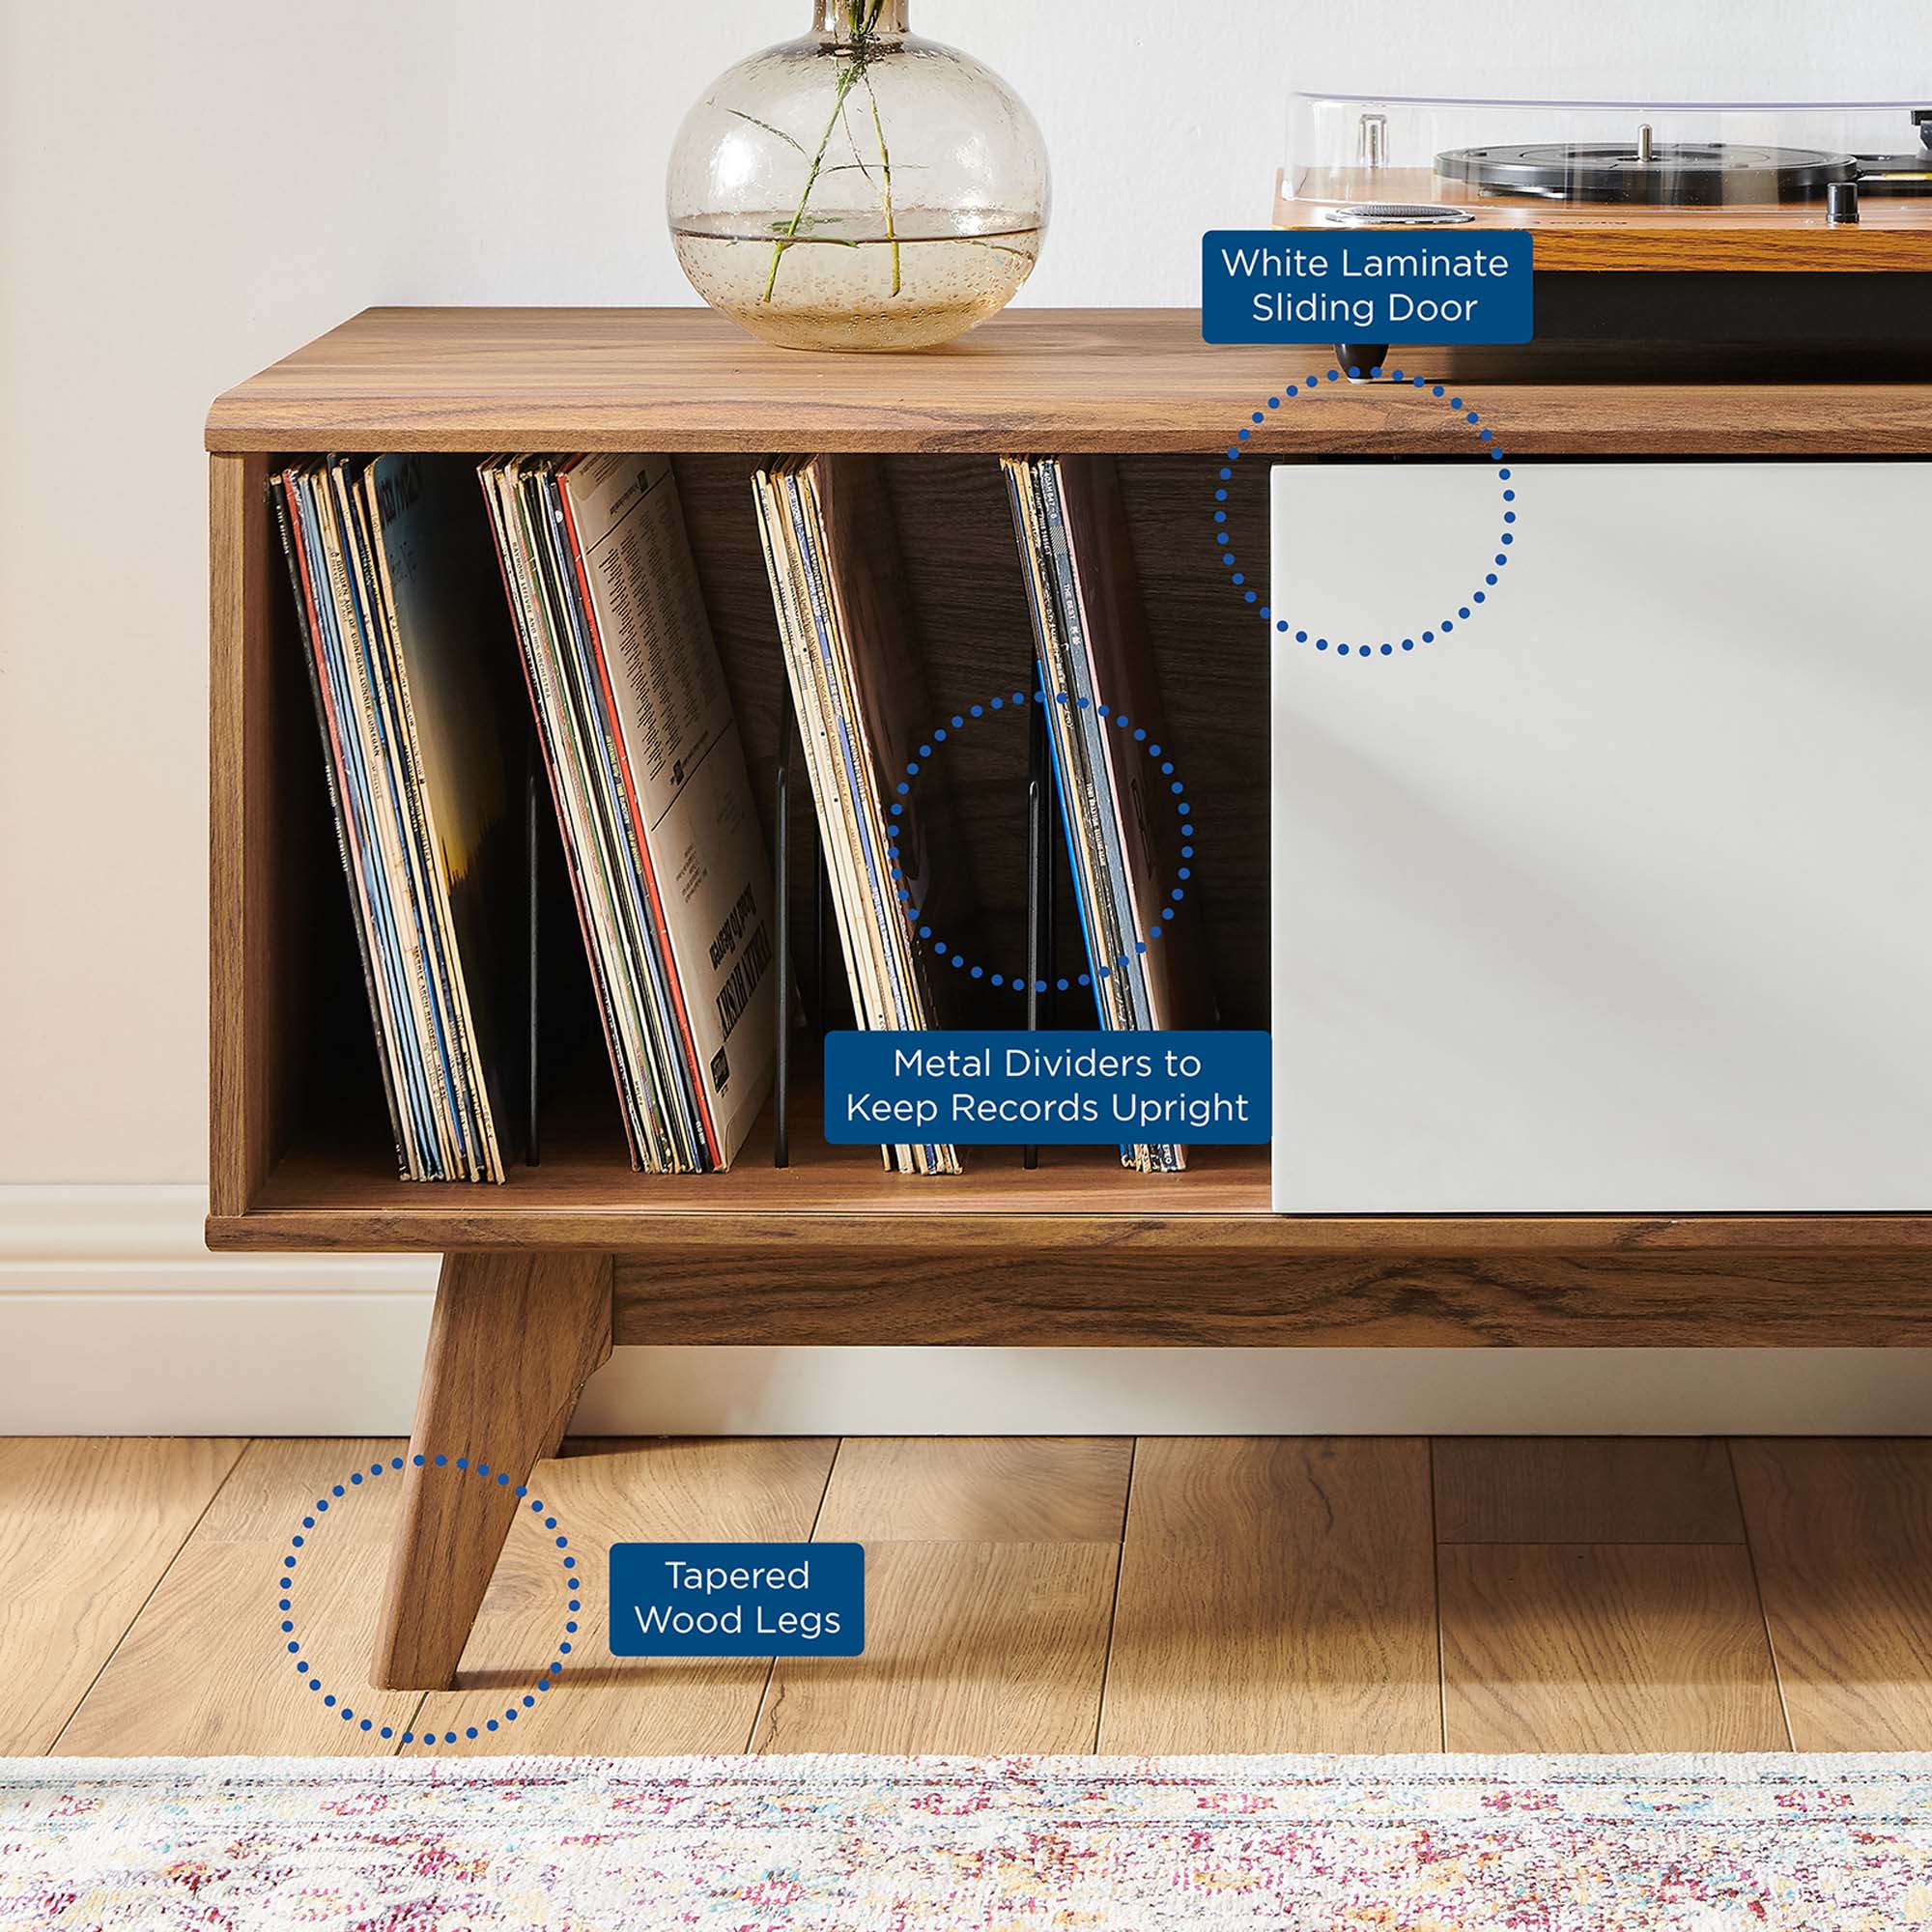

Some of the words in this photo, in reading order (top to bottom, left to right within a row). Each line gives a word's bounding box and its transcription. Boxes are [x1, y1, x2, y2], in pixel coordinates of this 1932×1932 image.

[336, 559, 348, 595] GOLDEN
[810, 552, 824, 594] COUNTRY
[818, 594, 830, 623] STARS
[1063, 582, 1071, 599] THE
[344, 598, 353, 615] AGE
[348, 617, 355, 629] OF
[511, 541, 525, 581] RAYMOND
[520, 582, 532, 613] LEFEVRE
[527, 617, 536, 634] AND
[535, 652, 551, 698] ORCHESTRA
[1065, 599, 1075, 619] BEST
[351, 632, 363, 675] DONEGAN
[358, 677, 370, 710] LONNIE
[366, 713, 380, 756] DONEGAN
[418, 983, 429, 1009] ARCH
[424, 1010, 437, 1051] RECORDS
